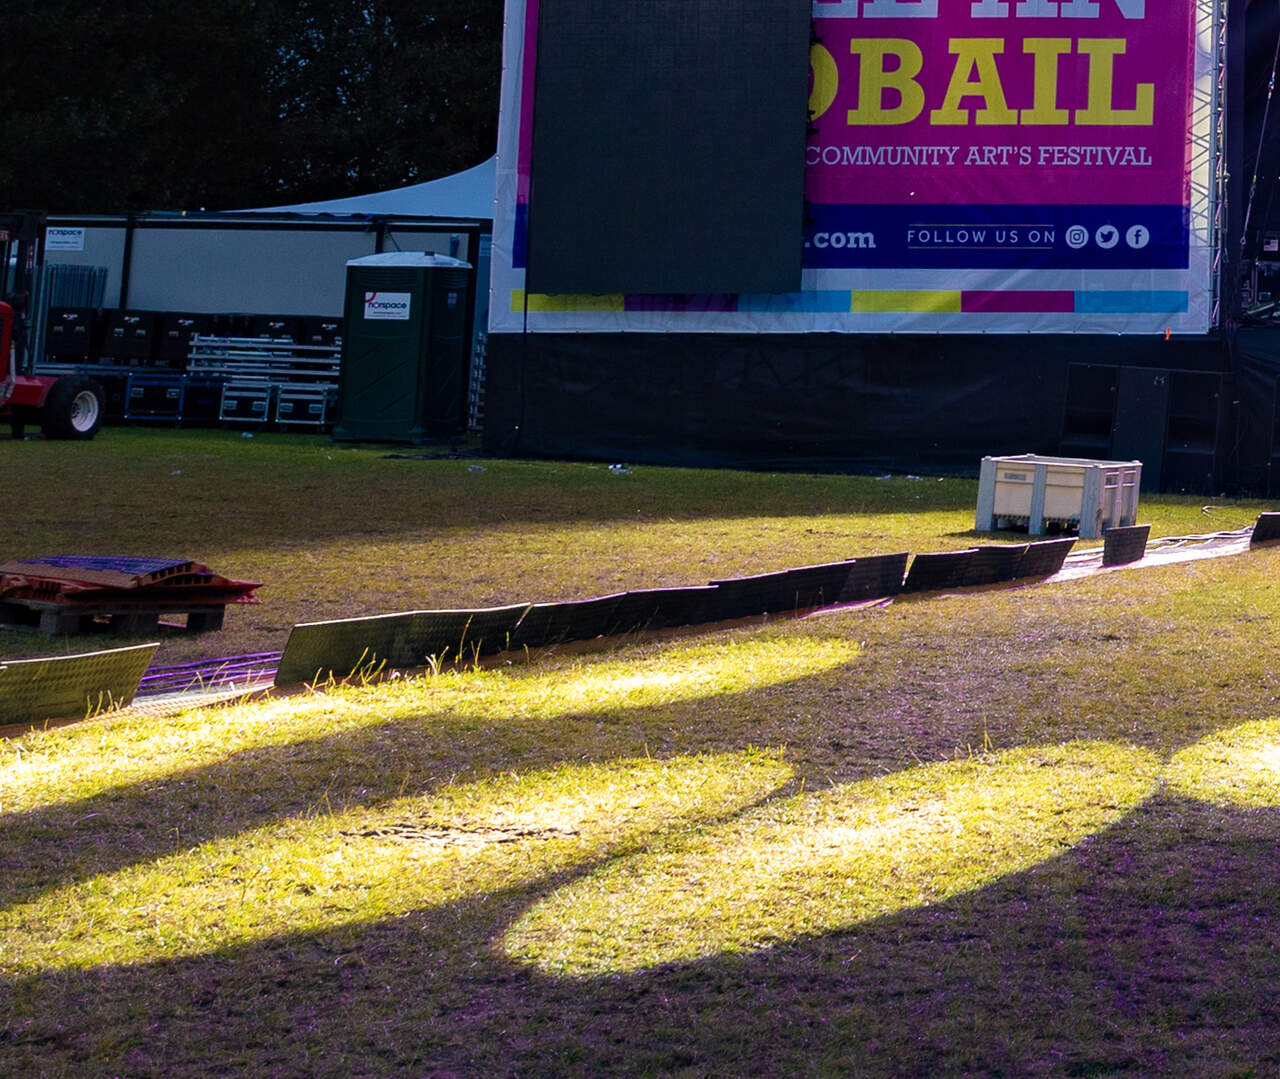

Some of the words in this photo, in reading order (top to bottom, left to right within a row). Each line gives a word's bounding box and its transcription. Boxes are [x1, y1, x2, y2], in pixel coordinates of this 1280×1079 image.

[808, 37, 1155, 126] BAIL
[806, 146, 959, 166] COMMUNITY
[964, 146, 1032, 166] ART'S
[1037, 146, 1153, 166] FESTIVAL
[907, 230, 987, 244] FOLLOW
[996, 230, 1019, 244] US
[1029, 230, 1056, 244] ON
